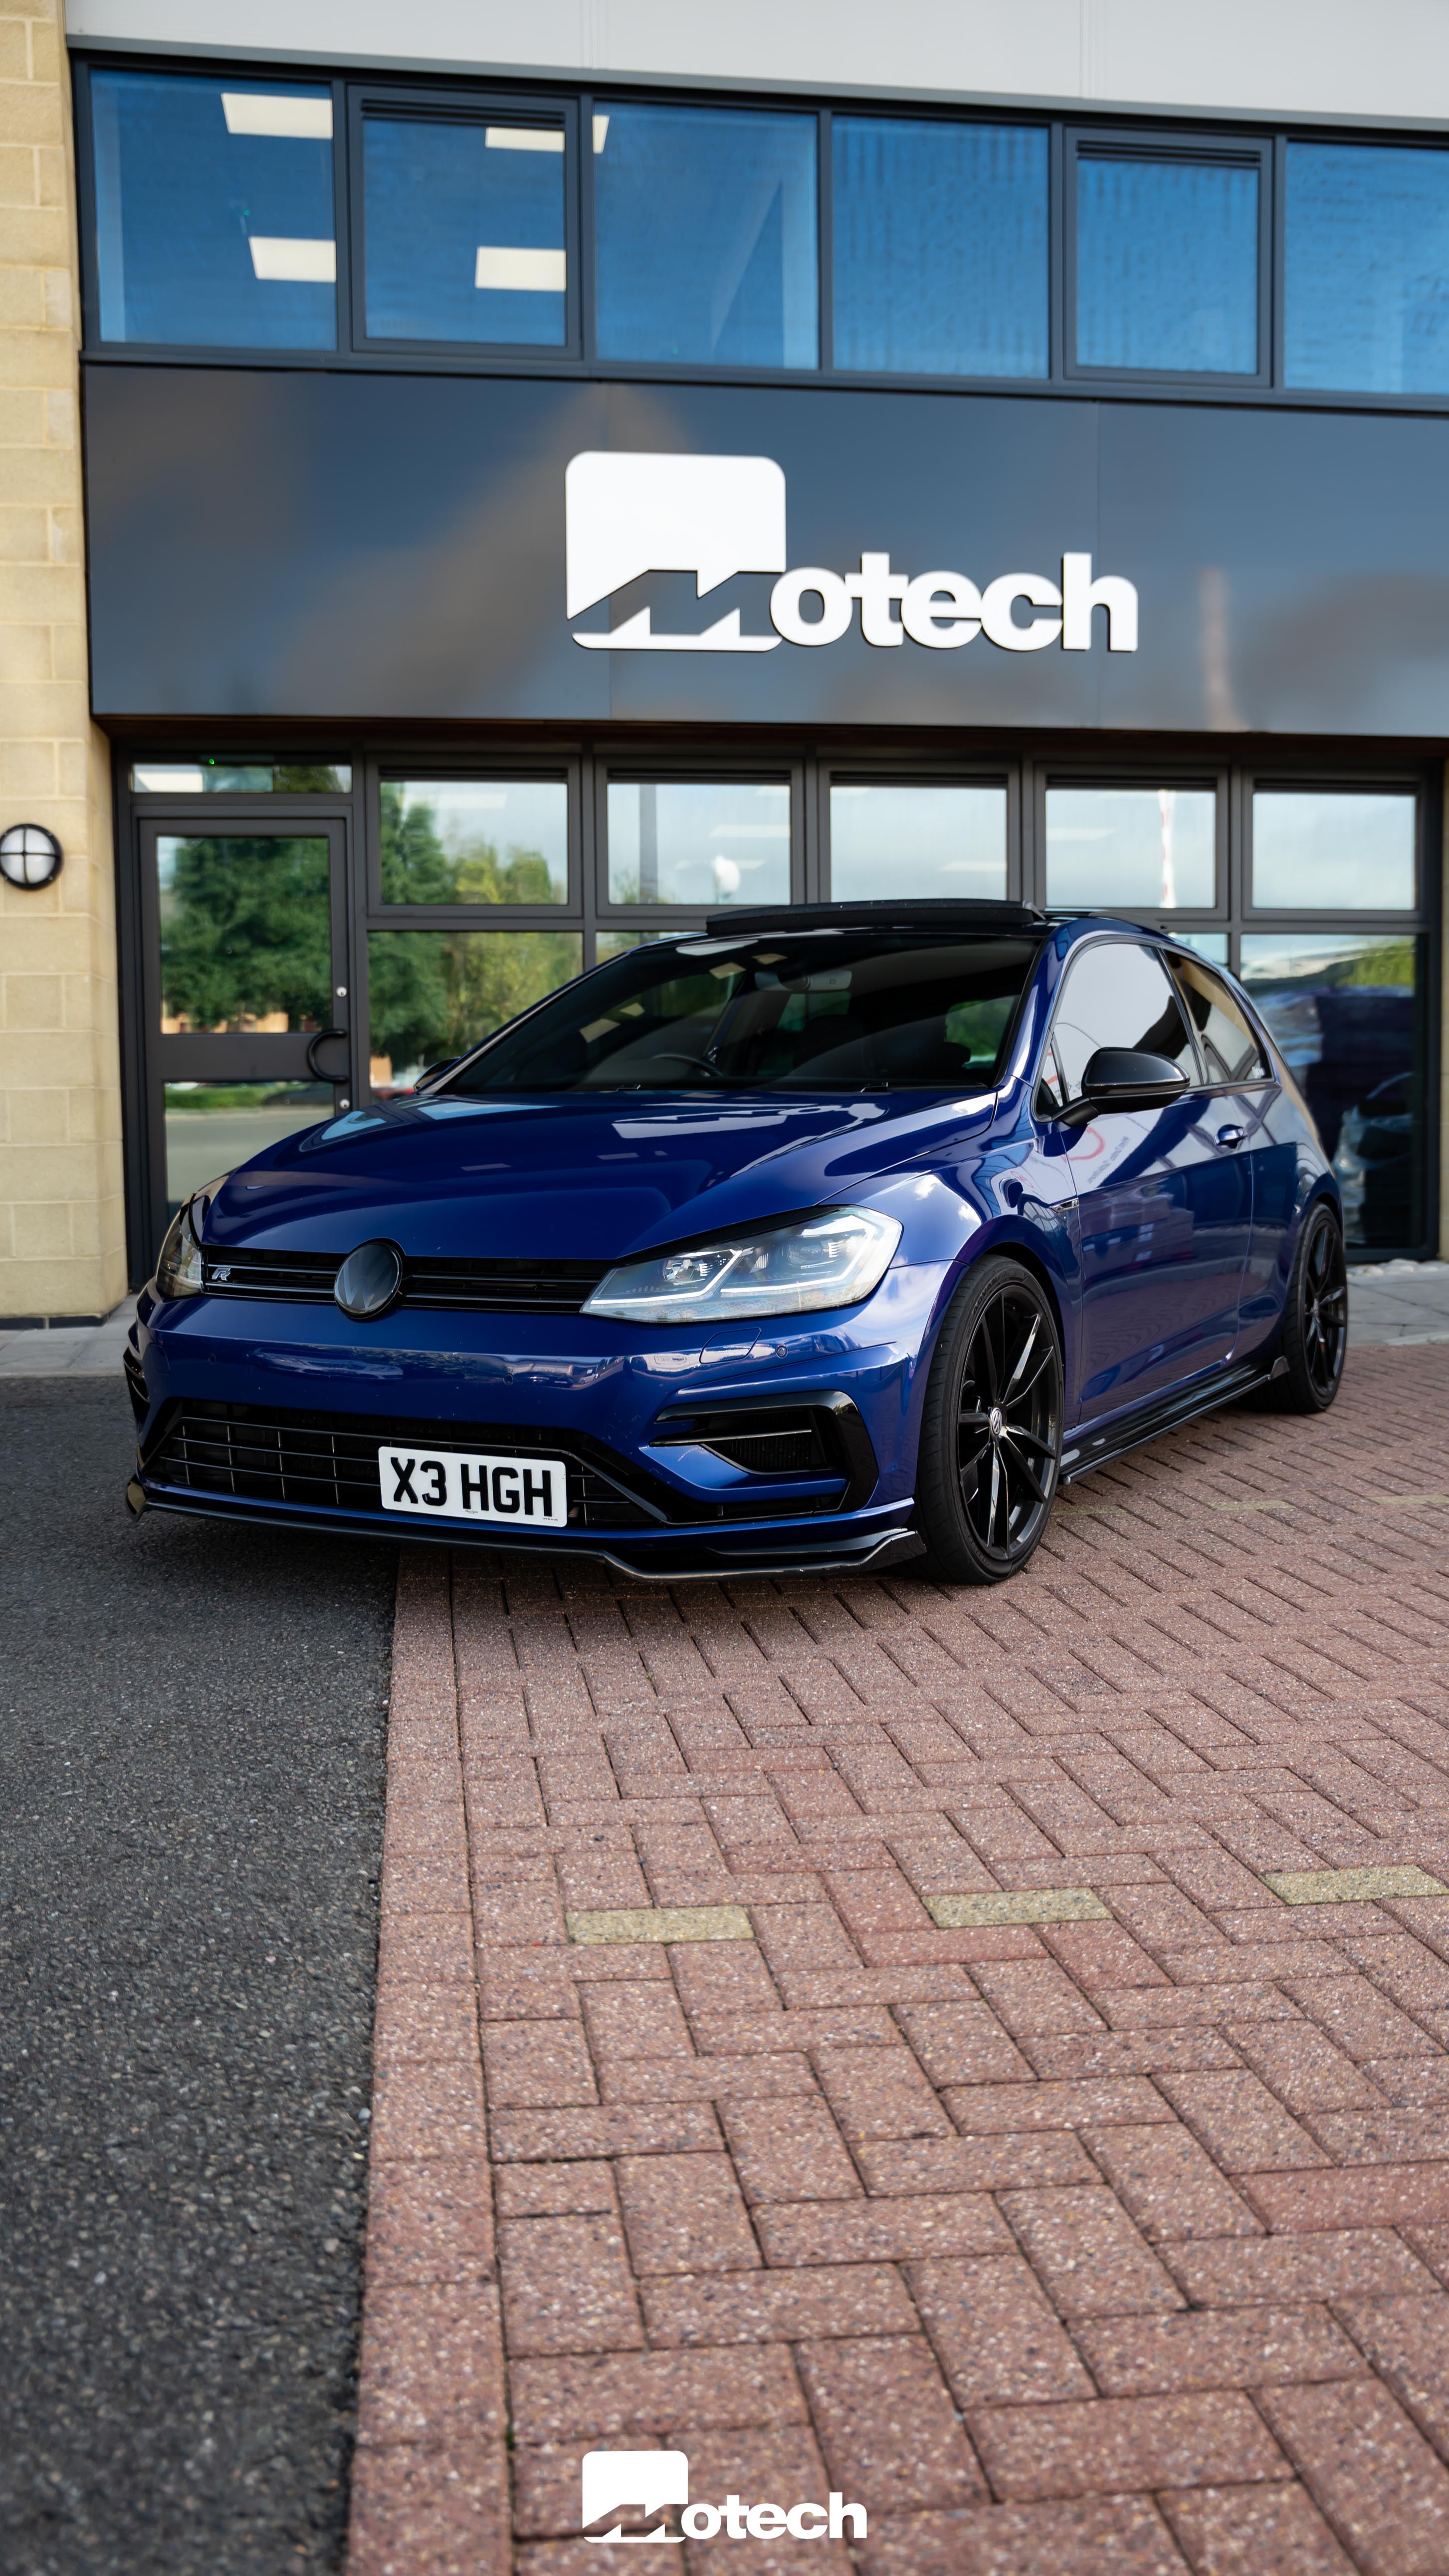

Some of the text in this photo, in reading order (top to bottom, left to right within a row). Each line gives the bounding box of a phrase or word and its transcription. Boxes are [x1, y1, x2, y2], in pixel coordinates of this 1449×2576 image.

[211, 1267, 231, 1281] R
[390, 1457, 553, 1517] X3 HGH
